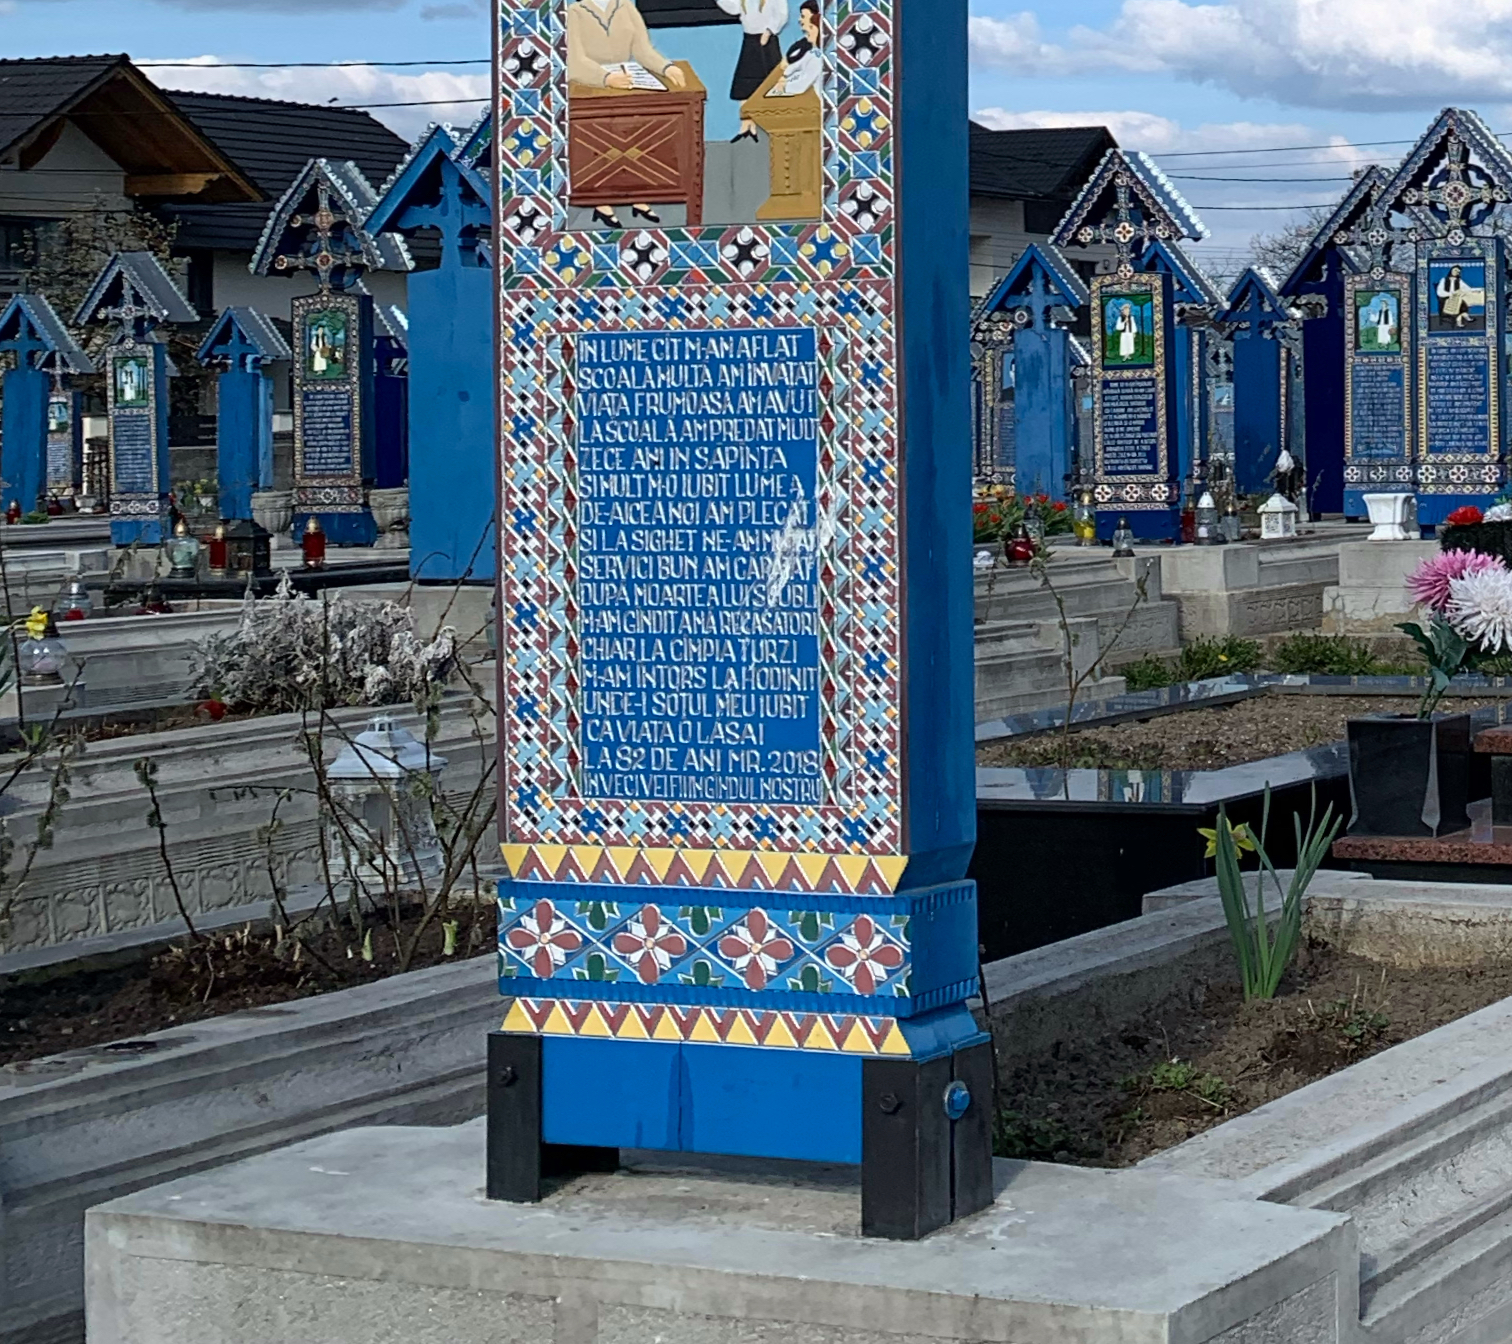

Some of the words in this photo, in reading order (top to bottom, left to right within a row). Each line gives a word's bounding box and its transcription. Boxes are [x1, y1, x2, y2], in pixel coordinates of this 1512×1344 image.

[600, 338, 650, 363] LUME
[736, 334, 802, 359] AFLAT
[717, 363, 745, 388] AM
[736, 390, 762, 415] AM
[763, 389, 815, 415] AVUT
[579, 419, 604, 444] LA
[679, 418, 707, 442] AM
[709, 417, 777, 442] PREDAT
[579, 446, 627, 471] ZECE
[630, 446, 665, 471] ANI
[599, 473, 646, 498] MULT
[681, 472, 731, 498] IUBIT
[668, 500, 700, 526] NOI
[704, 500, 734, 525] AM
[738, 500, 810, 525] PLECAT
[601, 529, 628, 552] LA
[630, 529, 698, 553] SIGHET
[580, 555, 654, 580] SERVICI
[657, 555, 699, 580] BUN
[701, 555, 731, 581] AM
[634, 583, 720, 607] MOARTEA
[721, 583, 750, 607] LUI
[581, 637, 636, 662] CHIAR
[640, 638, 666, 662] LA
[737, 638, 798, 664] TURZI
[712, 666, 740, 690] LA
[741, 666, 818, 692] HODINIT
[715, 692, 756, 718] MEU
[759, 694, 810, 719] IUBIT
[678, 720, 692, 744] O
[583, 746, 613, 770] LA
[615, 744, 647, 772] 82
[650, 746, 679, 771] DE
[682, 747, 721, 773] ANI
[728, 749, 767, 774] MR.
[767, 749, 819, 776] 2018
[599, 773, 639, 797] VECI
[639, 773, 668, 798] VEI
[760, 777, 821, 802] NOSTRU
